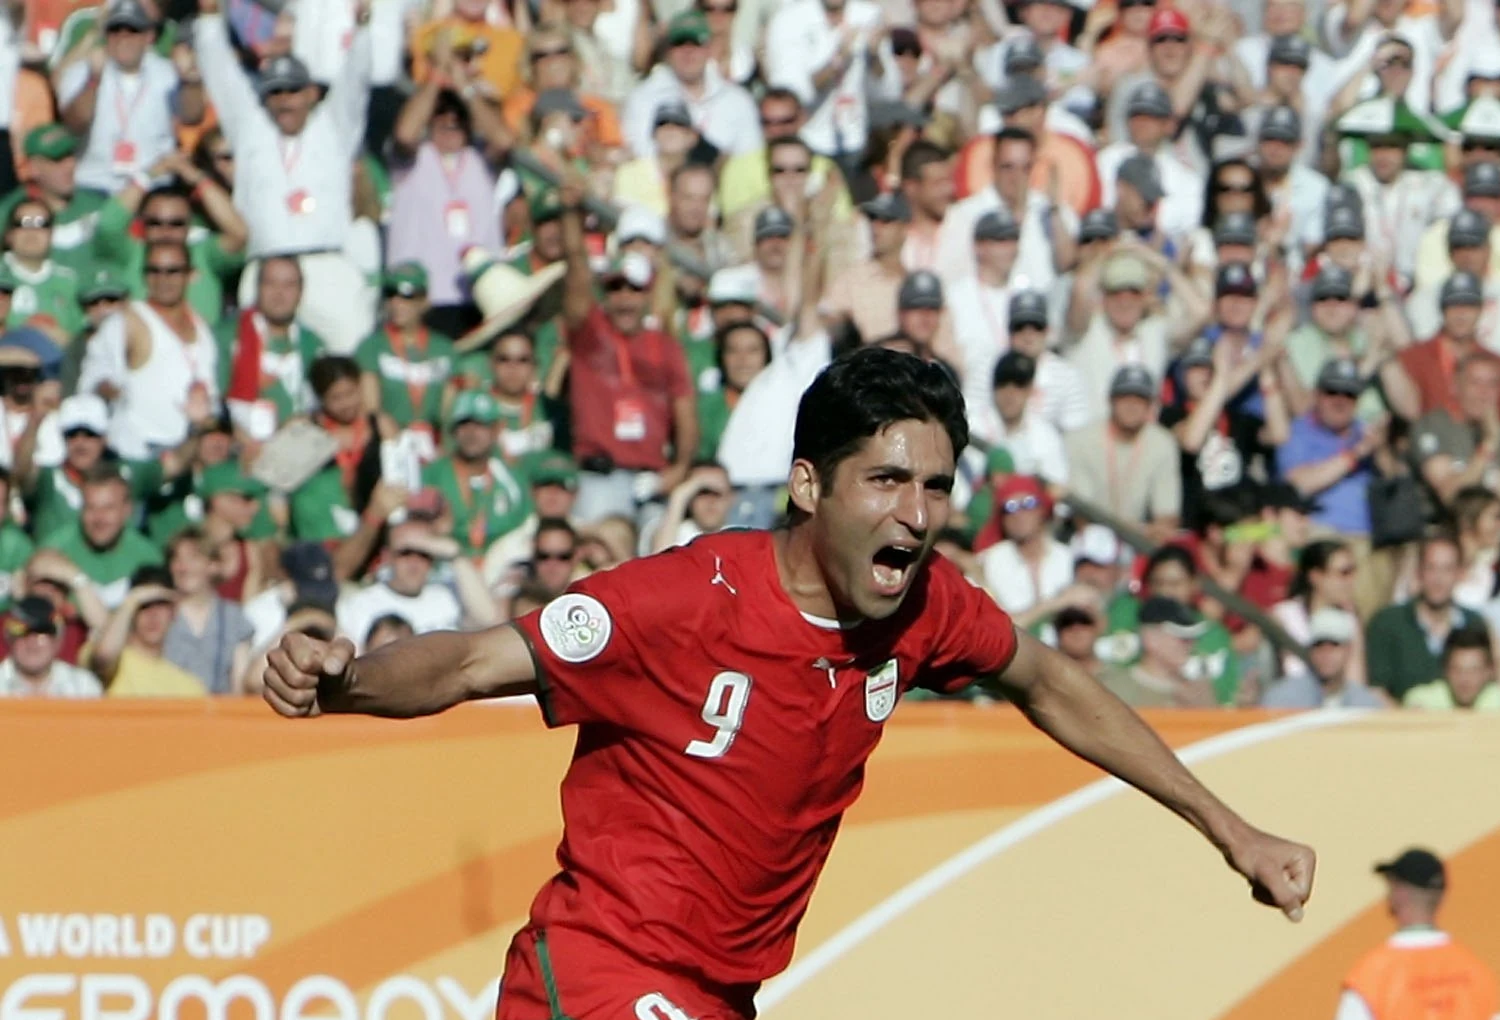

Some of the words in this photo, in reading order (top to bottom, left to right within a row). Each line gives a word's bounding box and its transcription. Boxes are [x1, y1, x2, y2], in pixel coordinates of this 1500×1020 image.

[684, 669, 752, 758] 9
[16, 911, 176, 959] WORLD
[182, 912, 272, 959] CUP
